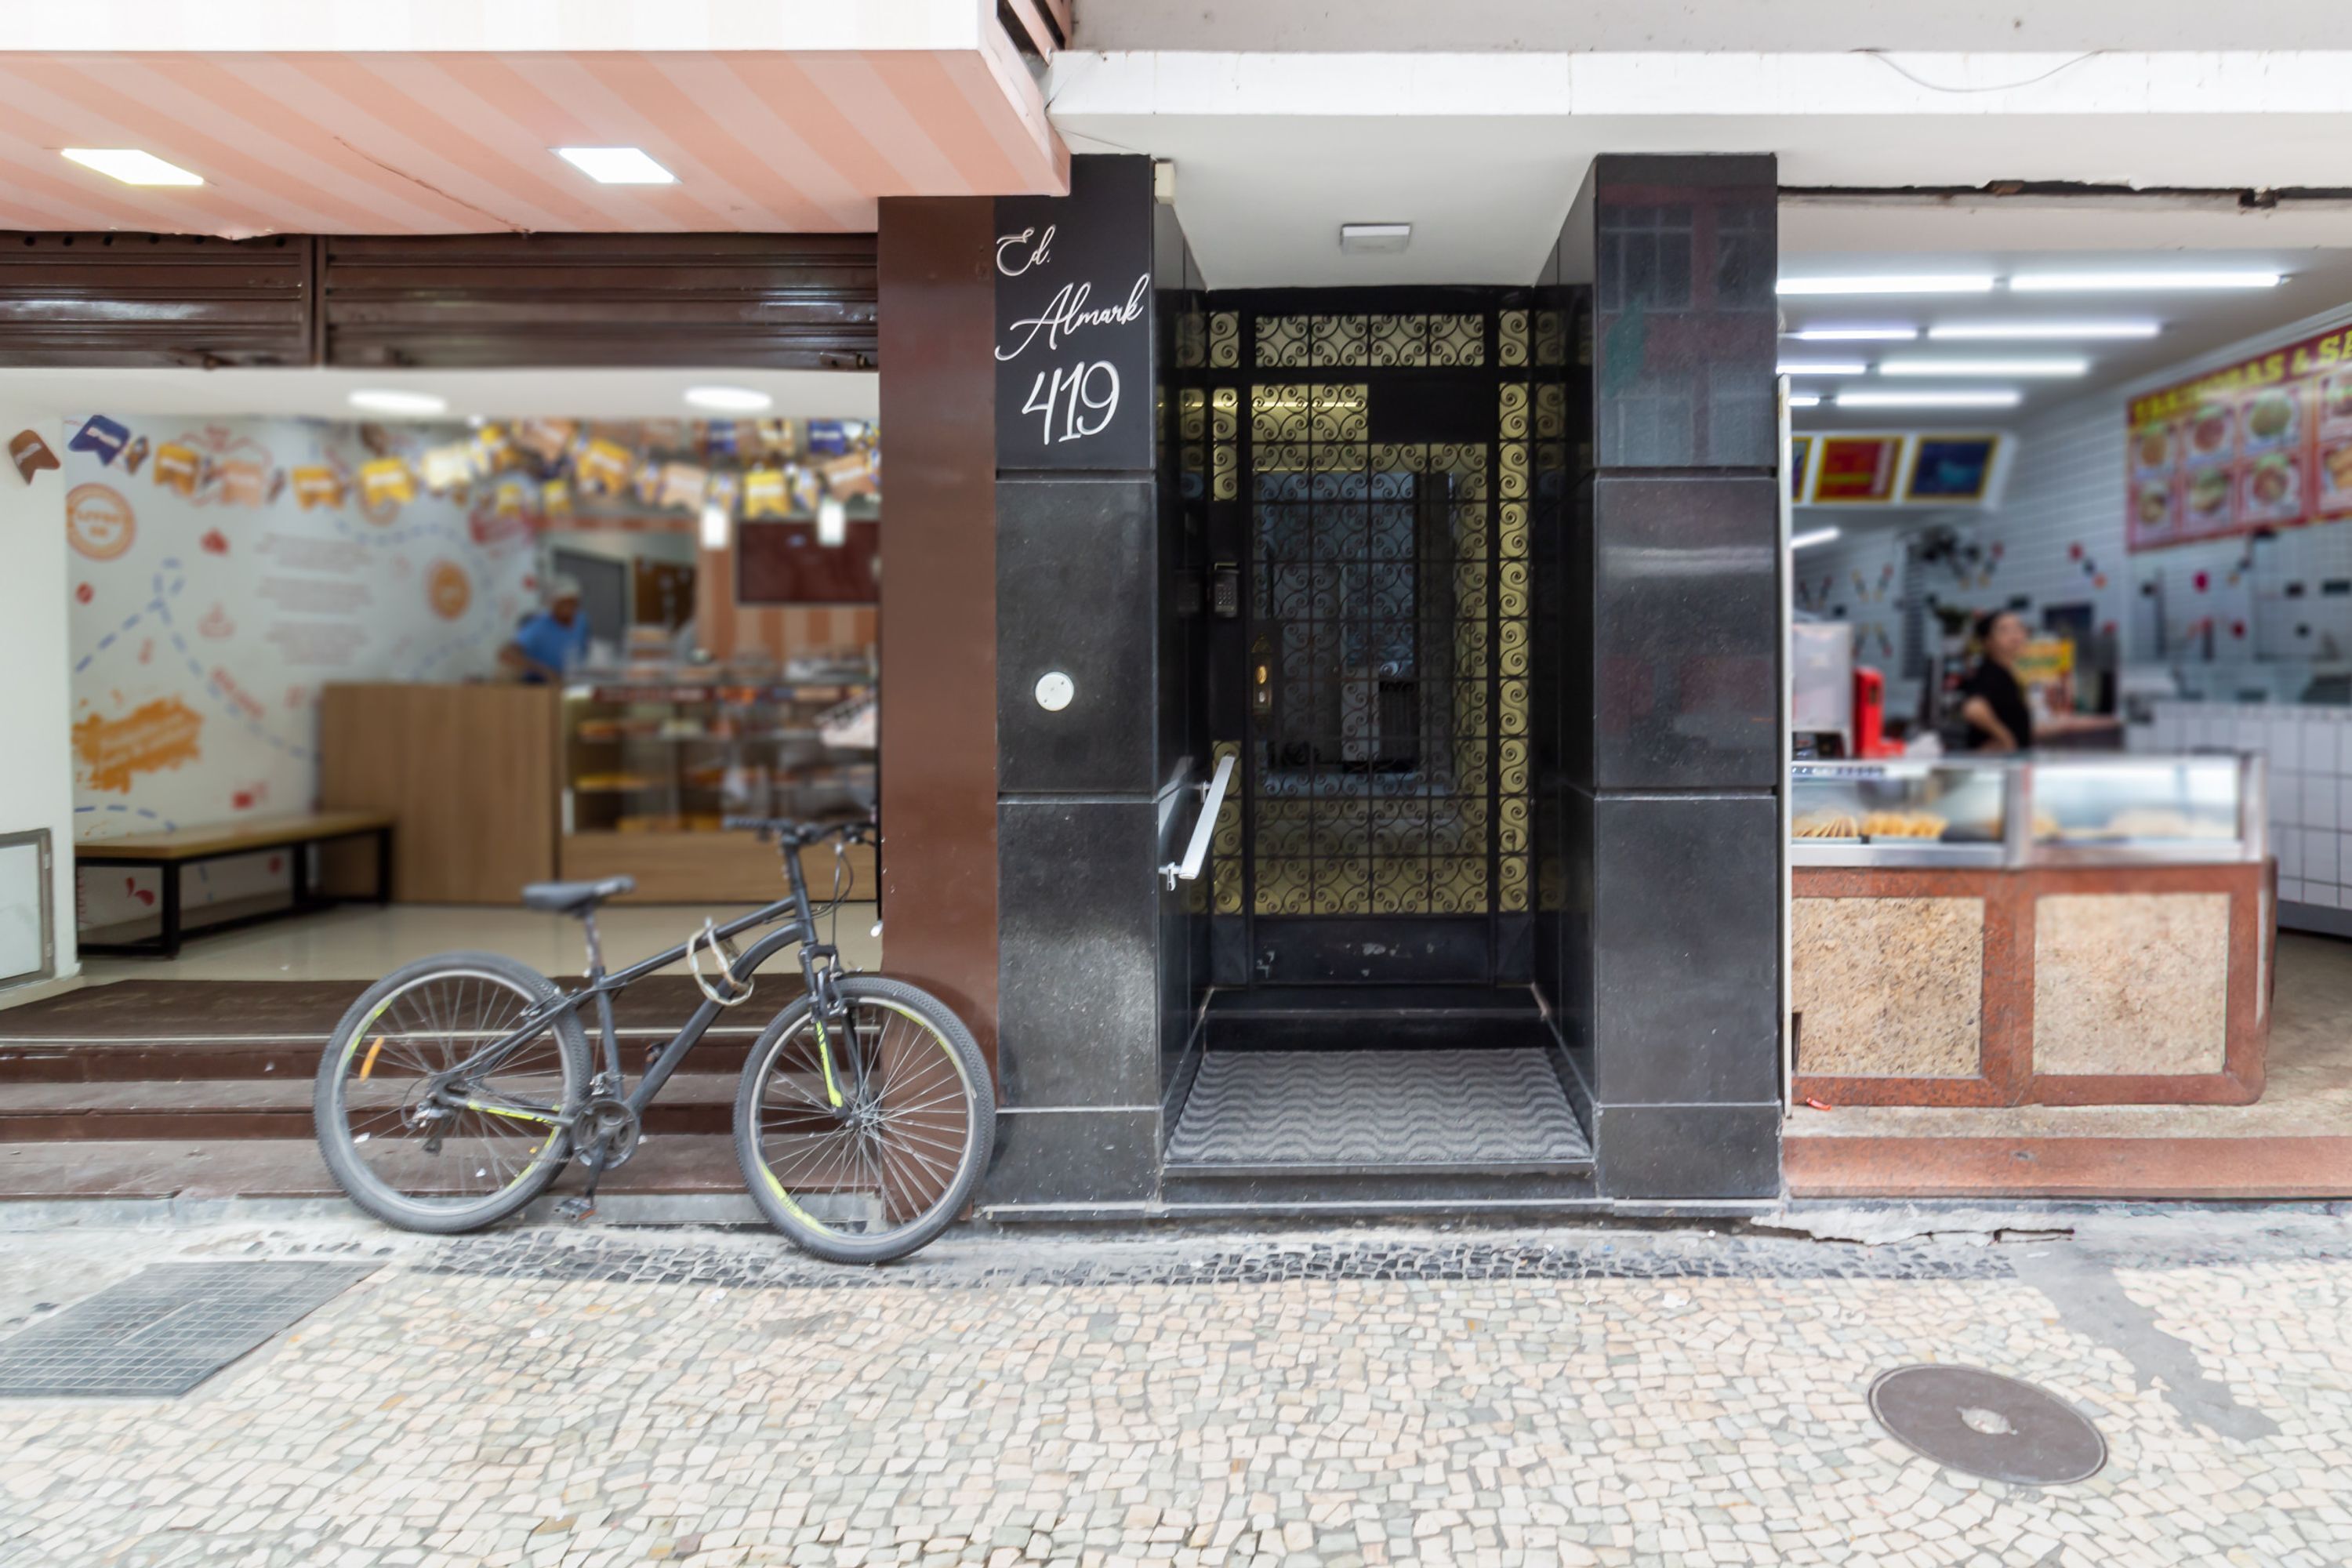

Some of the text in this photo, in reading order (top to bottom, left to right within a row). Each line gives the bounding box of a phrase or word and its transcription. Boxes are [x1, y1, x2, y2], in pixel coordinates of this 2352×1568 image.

[996, 224, 1056, 276] Ed.
[994, 272, 1151, 361] Almark
[1022, 361, 1120, 445] 419
